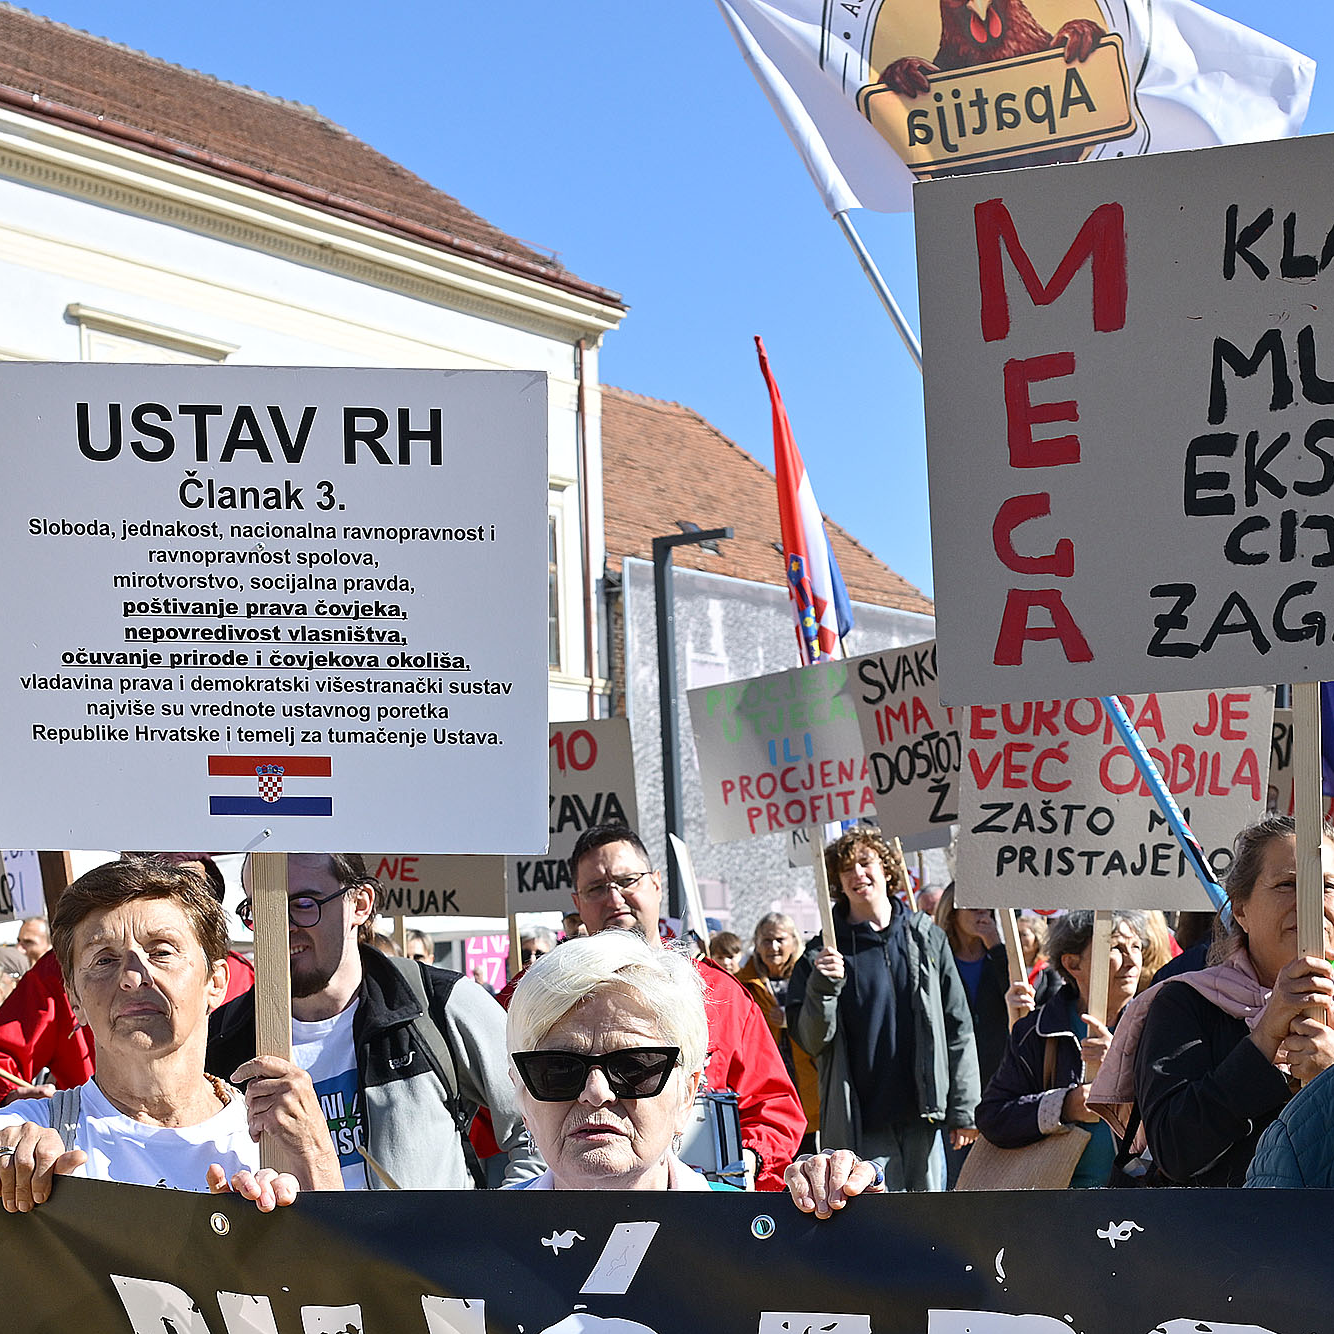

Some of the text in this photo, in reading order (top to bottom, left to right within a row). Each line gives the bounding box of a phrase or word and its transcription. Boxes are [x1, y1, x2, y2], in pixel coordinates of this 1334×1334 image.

[75, 401, 443, 467] USTAV RH
[973, 198, 1128, 667] MEGA
[178, 469, 347, 511] Članak 3.
[28, 518, 496, 544] Sloboda, jednakost, nacionalna ravnopravnost i
[148, 548, 380, 569] ravnopravnost spolova,
[113, 571, 416, 595] mirotvorstvo, socijalna pravda,
[123, 597, 408, 621] poštivanje prava čovjeka,
[124, 624, 408, 646] nepovredivost vlasništva,
[61, 647, 472, 672] očuvanje prirode i čovjekova okoliša,
[20, 673, 513, 695] vladavina prava i demokratski višestranački sustav
[87, 700, 450, 722] najviše su vrednote ustavnog poretka
[874, 696, 934, 746] IMA
[969, 691, 1252, 745] EUROPA JE
[32, 725, 504, 747] Republike Hrvatske i temelj za tumačenje Ustava.
[768, 733, 814, 767] ILI
[721, 756, 869, 806] PROCJENA
[967, 741, 1073, 793] VEĆ
[1099, 743, 1261, 802] ODBILA
[746, 786, 876, 836] PROFITA
[971, 799, 1115, 836] ZAŠTO
[376, 856, 420, 883] NE
[383, 887, 461, 915] NIJAK
